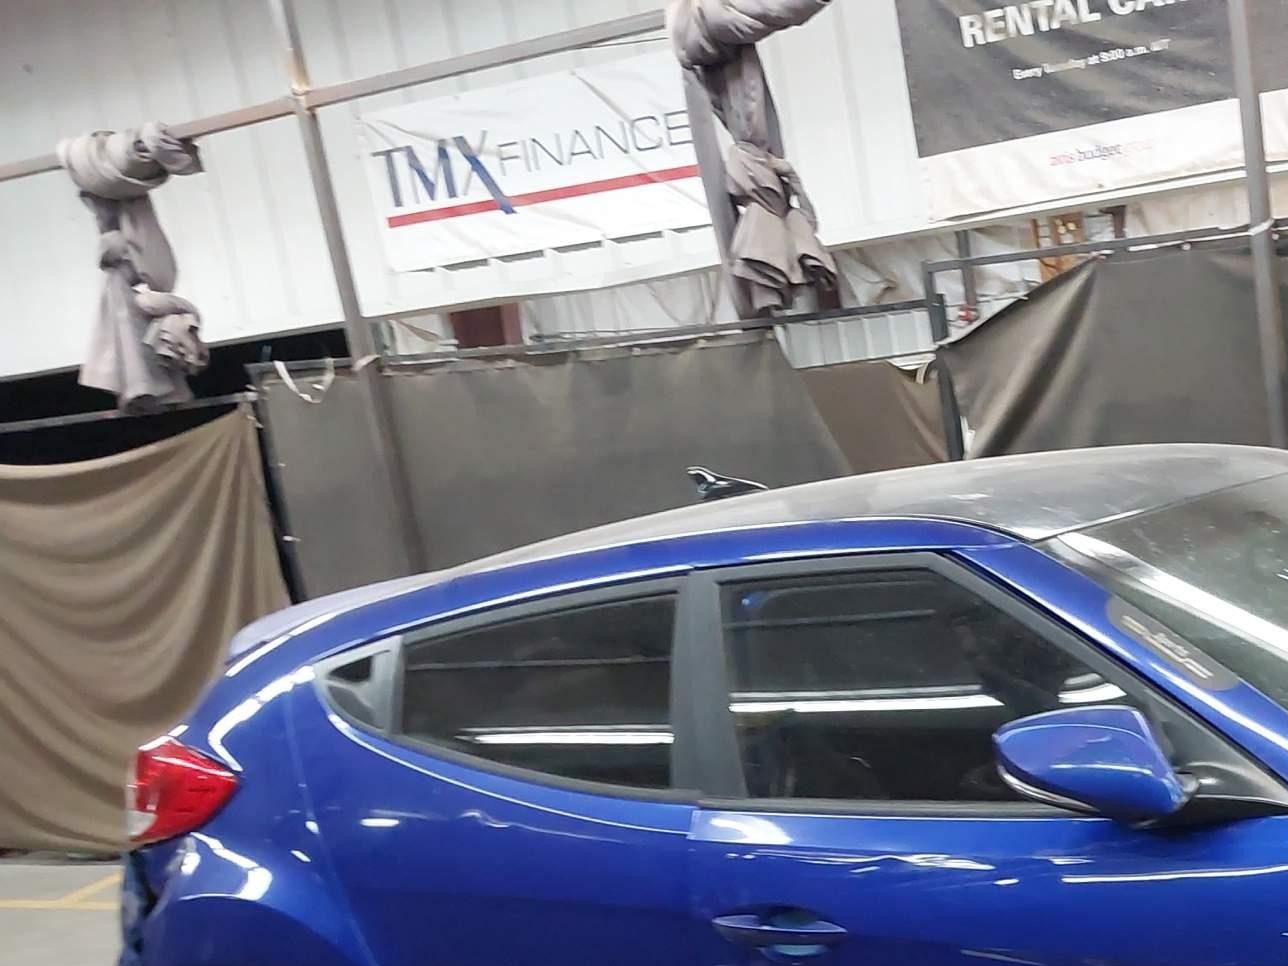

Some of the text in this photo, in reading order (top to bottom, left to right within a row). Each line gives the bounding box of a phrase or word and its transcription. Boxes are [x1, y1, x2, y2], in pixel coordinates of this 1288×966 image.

[958, 0, 1101, 48] RENTAL
[370, 109, 694, 215] TMX FINANCE
